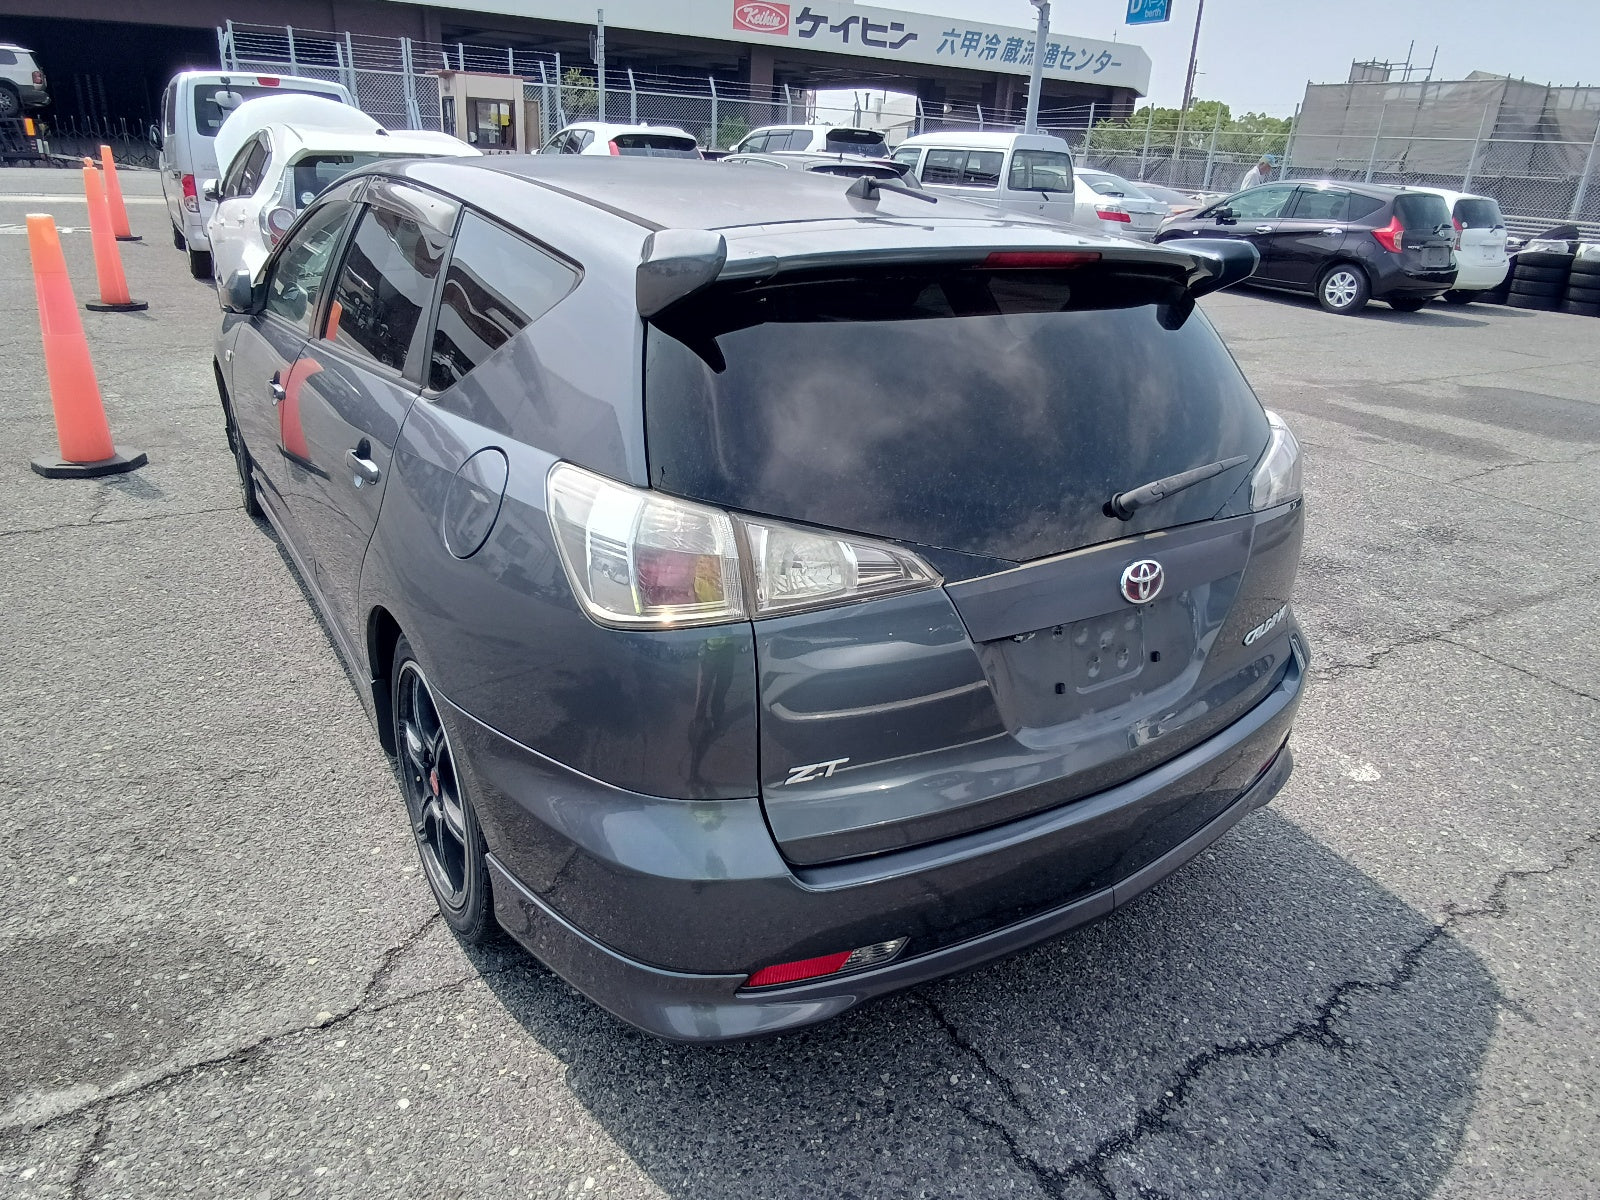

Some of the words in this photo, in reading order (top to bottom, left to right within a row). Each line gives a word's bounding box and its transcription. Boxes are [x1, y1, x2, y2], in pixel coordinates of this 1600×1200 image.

[743, 7, 781, 27] Keihin
[795, 7, 918, 49] ケイヒン
[784, 757, 850, 785] ZT
